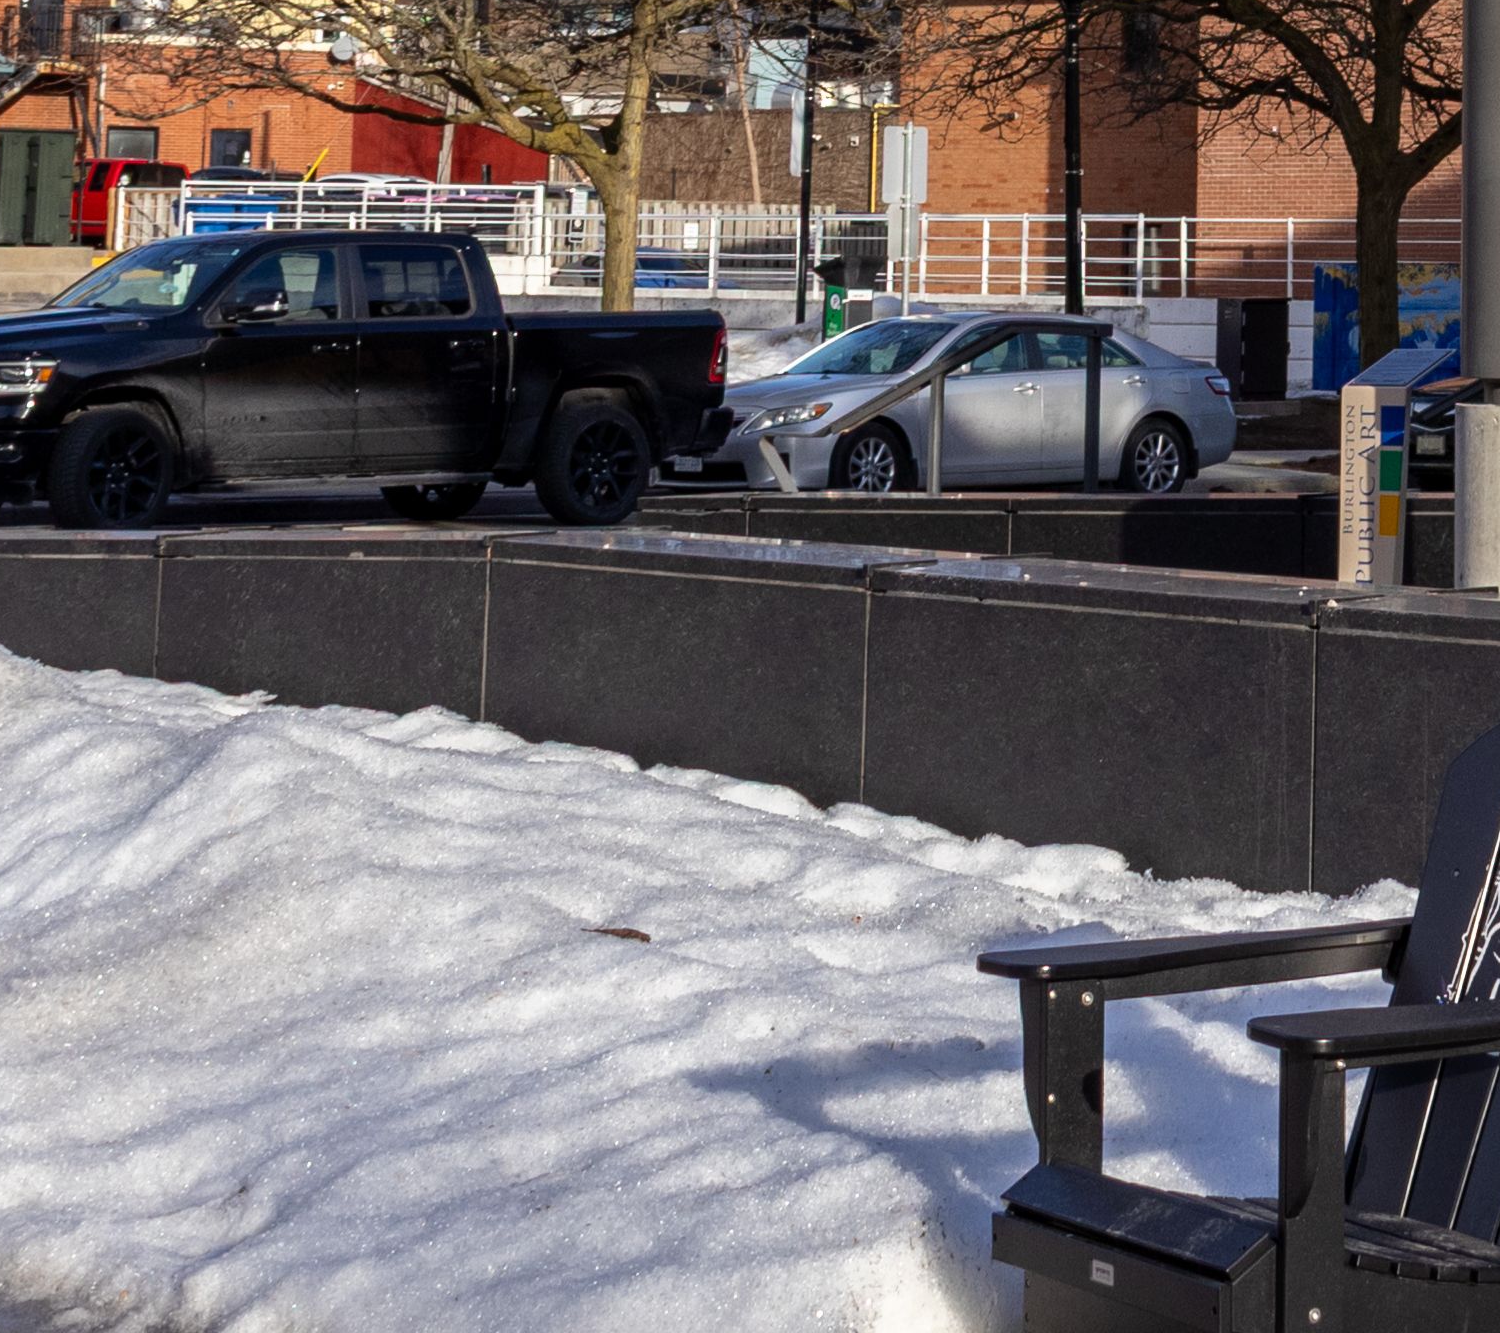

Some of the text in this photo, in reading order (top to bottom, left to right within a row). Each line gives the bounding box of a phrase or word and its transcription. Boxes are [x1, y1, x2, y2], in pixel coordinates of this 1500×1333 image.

[1343, 404, 1356, 534] BURLINGTON
[1355, 405, 1376, 584] PUBLIC ART
